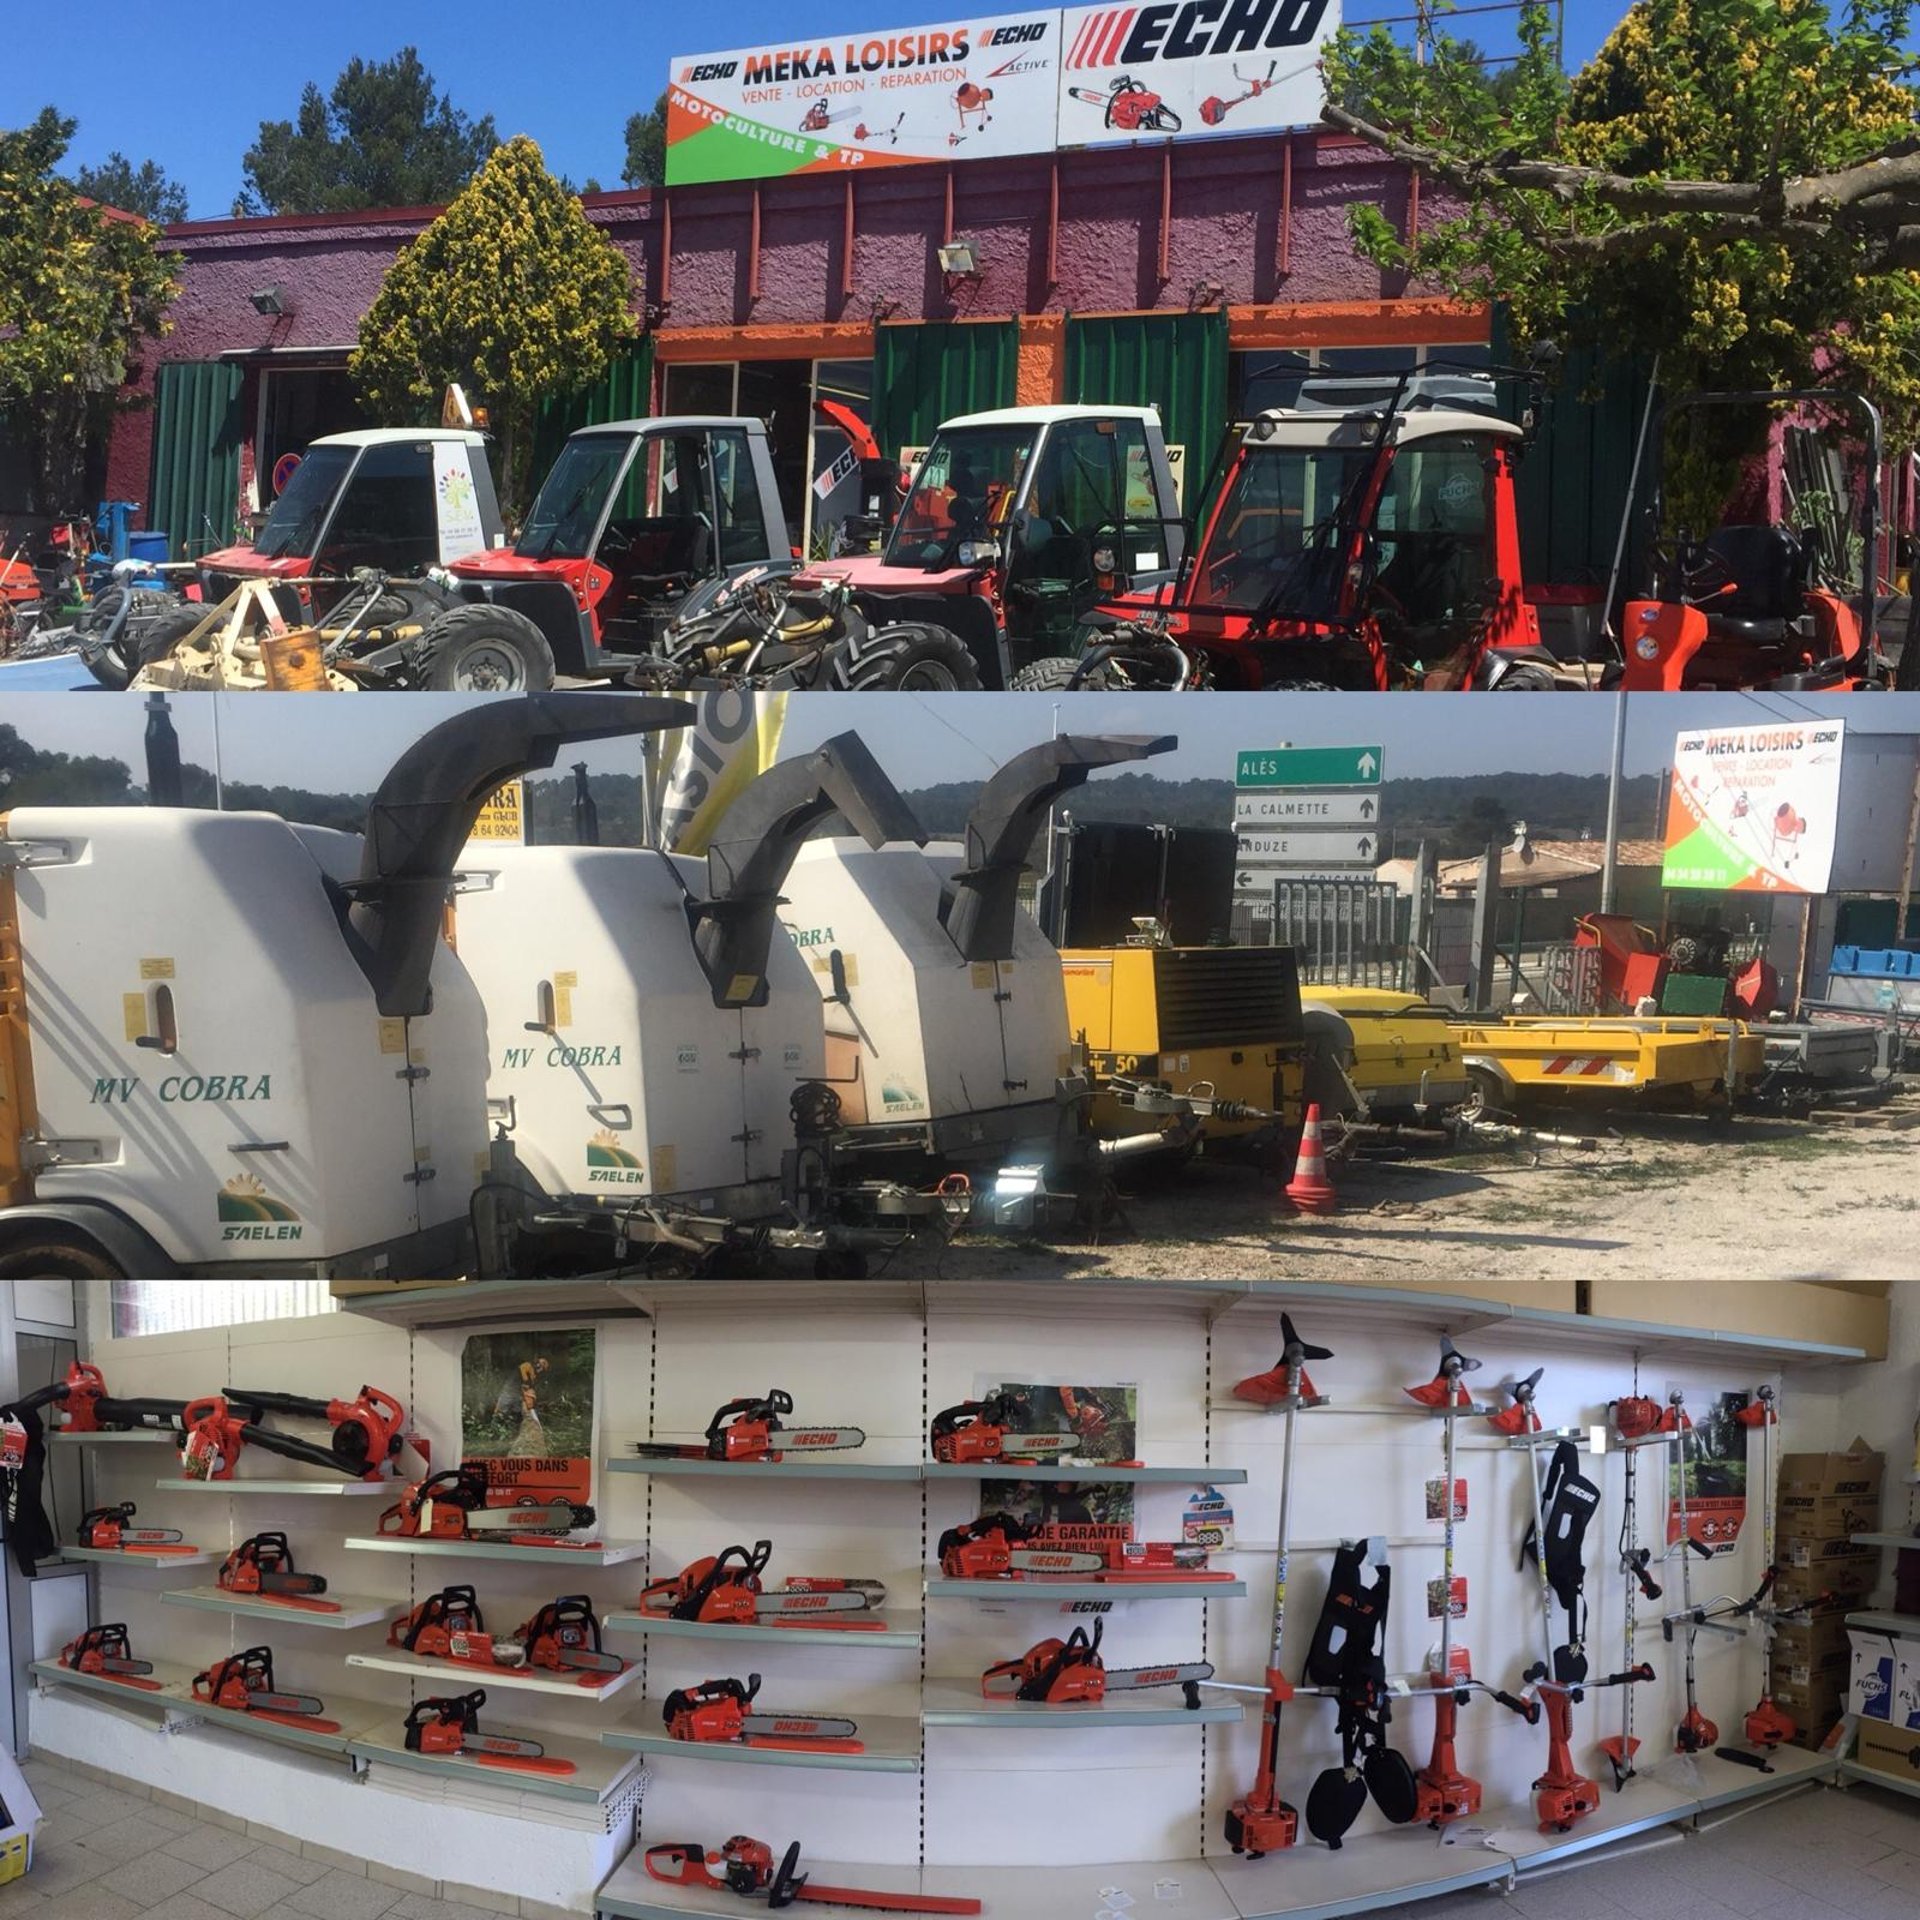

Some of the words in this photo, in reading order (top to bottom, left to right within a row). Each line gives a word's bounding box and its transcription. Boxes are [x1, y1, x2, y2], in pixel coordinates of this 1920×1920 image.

[991, 22, 1048, 47] ECHO
[1120, 0, 1330, 64] ECHO
[743, 47, 836, 86] MEKA
[845, 29, 970, 72] LOISIRS
[690, 61, 738, 82] ECHO
[1007, 59, 1048, 73] ACTIVE
[742, 88, 782, 104] VENTE
[796, 79, 865, 98] LOCATION
[881, 67, 967, 89] REPARATION
[671, 90, 807, 154] MOTOCULTURE
[814, 144, 829, 160] &
[840, 149, 865, 166] TP
[911, 450, 950, 465] ECHO
[1706, 733, 1746, 755] MEKA
[1749, 730, 1804, 752] LOISIRS
[1813, 731, 1838, 744] ECHO
[1684, 740, 1705, 751] ECHO
[1746, 757, 1793, 772] LOCATION
[1237, 804, 1252, 816] LA
[1260, 803, 1330, 816] CALMETTE
[789, 927, 836, 947] OBRA
[502, 1048, 535, 1069] MV
[547, 1045, 622, 1068] COBRA
[1115, 1055, 1138, 1074] 50
[90, 1077, 140, 1104] MV
[159, 1074, 272, 1102] COBRA
[588, 1170, 644, 1184] SAELEN
[222, 1225, 303, 1241] SAELEN
[801, 1432, 838, 1446] ECHO
[1032, 1437, 1060, 1448] ECHO
[501, 1459, 532, 1471] VOUS
[535, 1460, 569, 1473] DANS
[1572, 1486, 1597, 1503] ECHO
[1198, 1501, 1225, 1511] ECHO
[513, 1512, 548, 1525] ECHO
[1037, 1526, 1055, 1540] DE
[1059, 1526, 1129, 1540] GARANTIE
[1037, 1555, 1073, 1567] ECHO
[792, 1596, 829, 1608] ECHO
[1071, 1601, 1114, 1613] ECHO
[1145, 1668, 1178, 1682] ECHO
[1856, 1678, 1889, 1693] FUCHS
